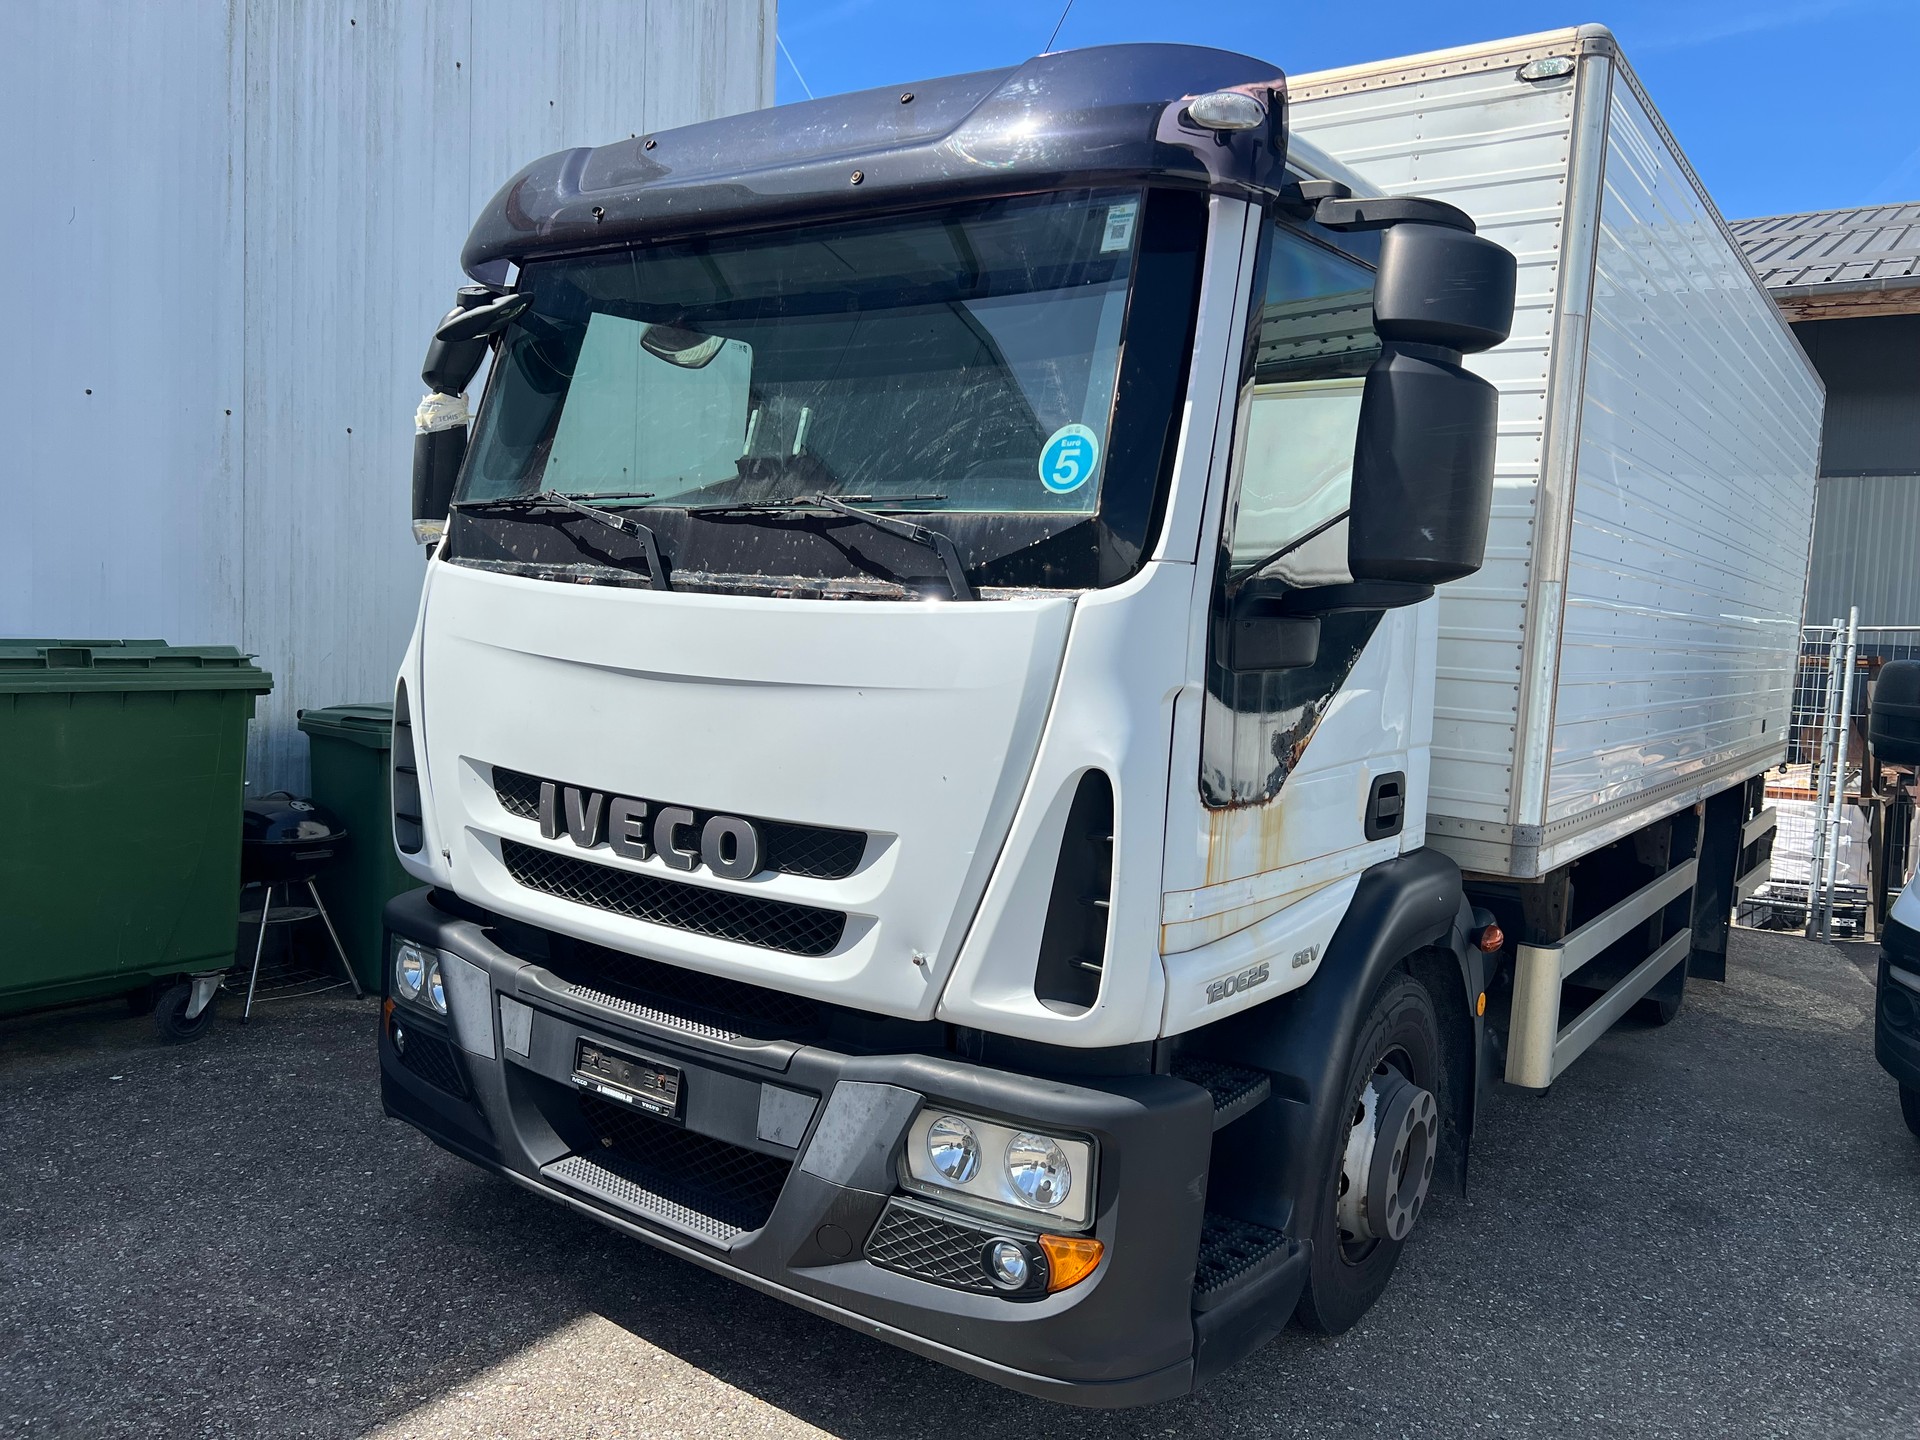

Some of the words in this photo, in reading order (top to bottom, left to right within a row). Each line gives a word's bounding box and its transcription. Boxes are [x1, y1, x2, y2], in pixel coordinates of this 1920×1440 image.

[1052, 448, 1081, 485] 5
[1061, 439, 1081, 447] Euro
[539, 781, 760, 880] IVECO
[1206, 962, 1270, 1005] 120E25
[1291, 943, 1321, 969] EEV
